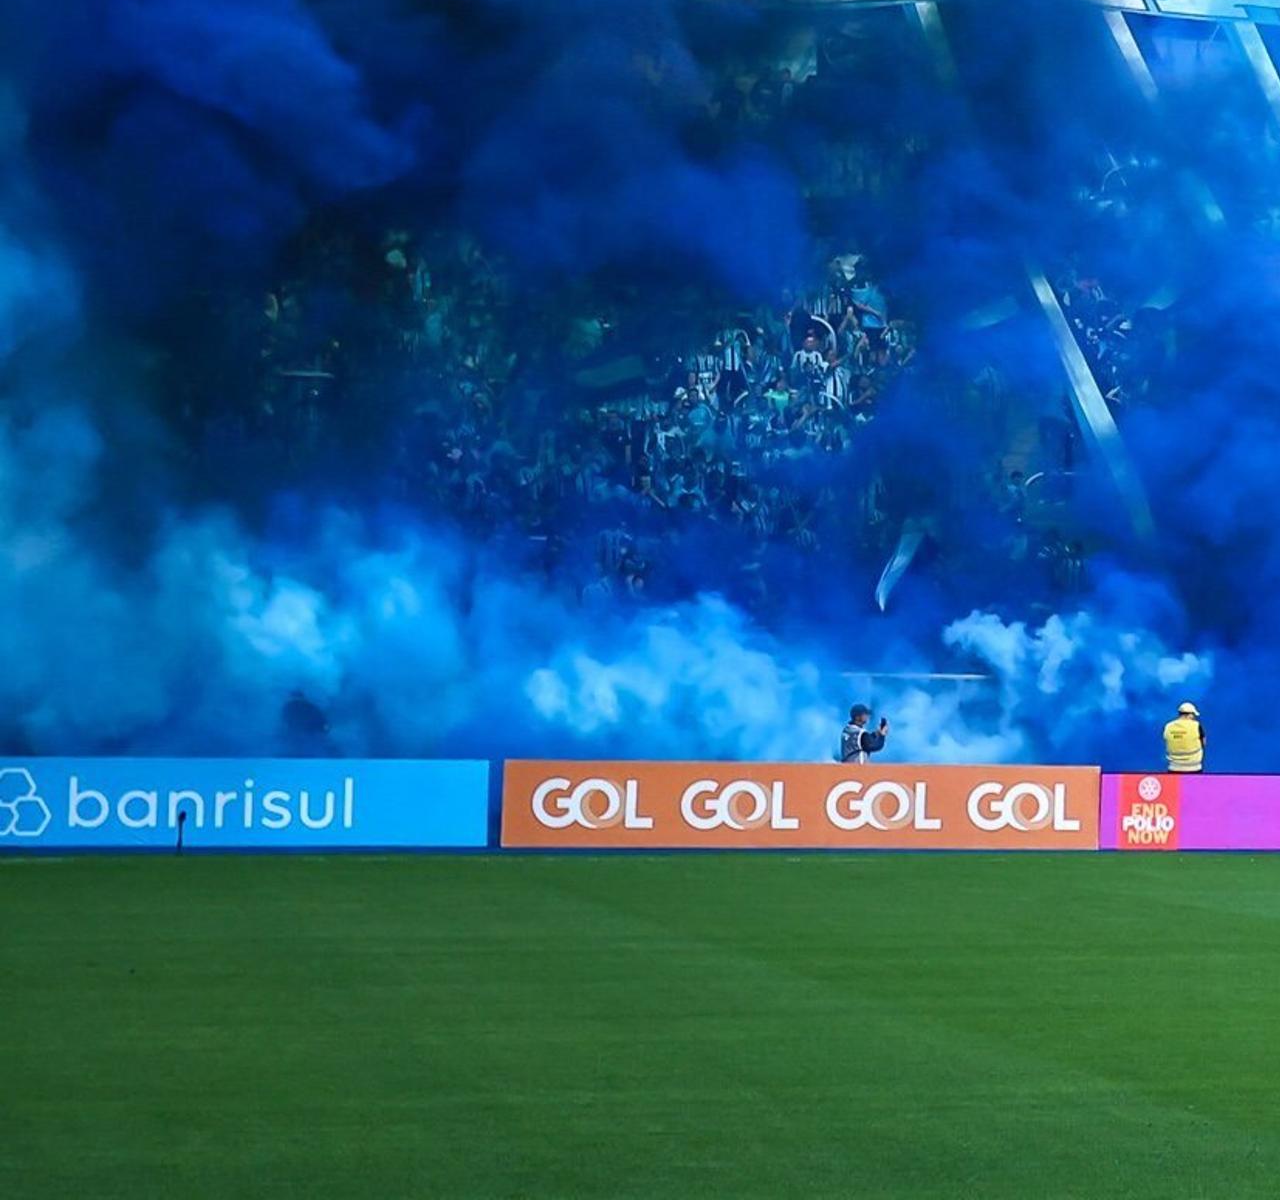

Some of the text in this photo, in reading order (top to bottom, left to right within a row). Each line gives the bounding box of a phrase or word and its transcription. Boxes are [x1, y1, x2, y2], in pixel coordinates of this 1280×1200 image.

[69, 777, 355, 830] banrisul
[532, 778, 1080, 832] GOL GOL GOL GOL
[1132, 804, 1167, 817] END
[1123, 816, 1174, 832] POLIO
[1128, 829, 1169, 844] NOW
